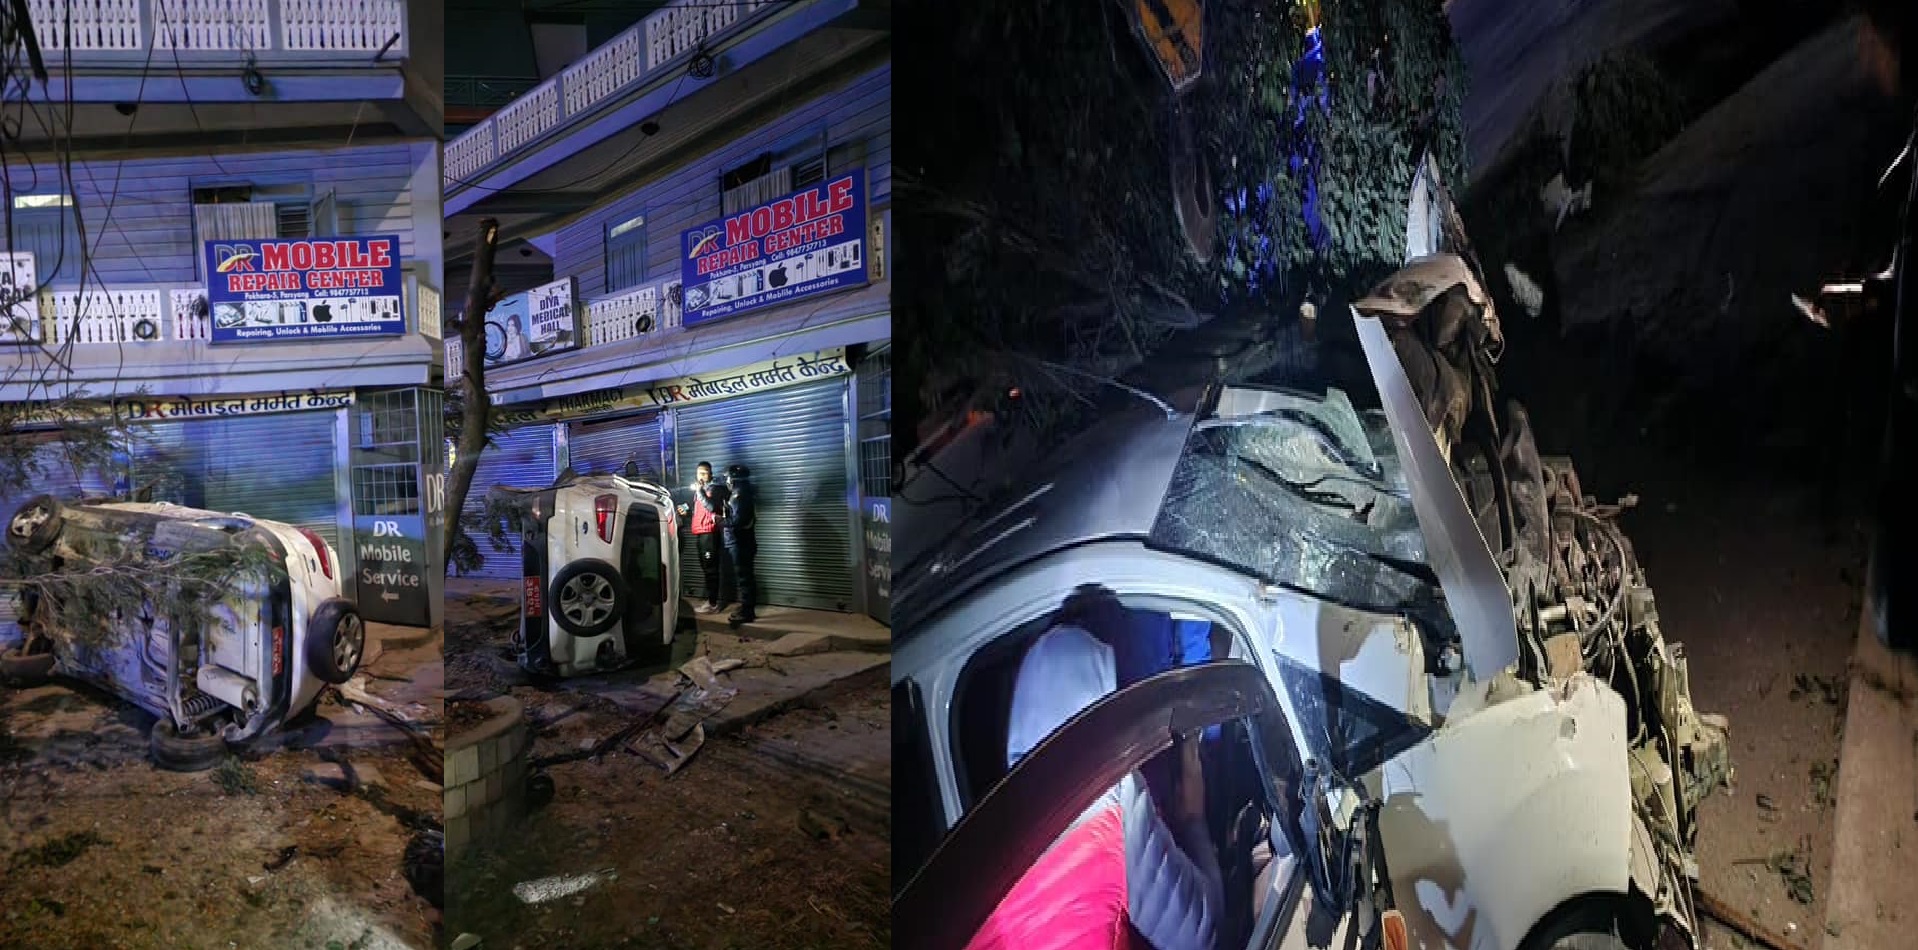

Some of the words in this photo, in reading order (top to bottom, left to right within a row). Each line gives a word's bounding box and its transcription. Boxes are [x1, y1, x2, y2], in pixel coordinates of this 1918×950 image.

[725, 176, 852, 247] MOBILE
[697, 241, 759, 275] REPAIR
[764, 214, 844, 255] CENTER
[262, 240, 392, 272] MOBILE
[228, 272, 301, 292] REPAIR
[306, 269, 383, 289] CENTER
[539, 295, 560, 311] DIYA
[734, 297, 757, 310] Unlock
[794, 277, 839, 294] Accessories
[531, 306, 570, 326] MEDICAL
[275, 326, 301, 335] Unlock
[302, 326, 308, 334] &
[340, 323, 382, 332] Accessories
[540, 320, 560, 335] HALL
[684, 376, 749, 399] मोबाइल
[747, 361, 797, 388] मर्मत
[127, 401, 167, 419] DR
[170, 395, 246, 417] मोबाइल
[250, 390, 301, 412] मर्मत
[872, 503, 889, 523] DR
[373, 520, 403, 537] DR
[360, 543, 412, 562] Mobile
[362, 567, 419, 587] Service
